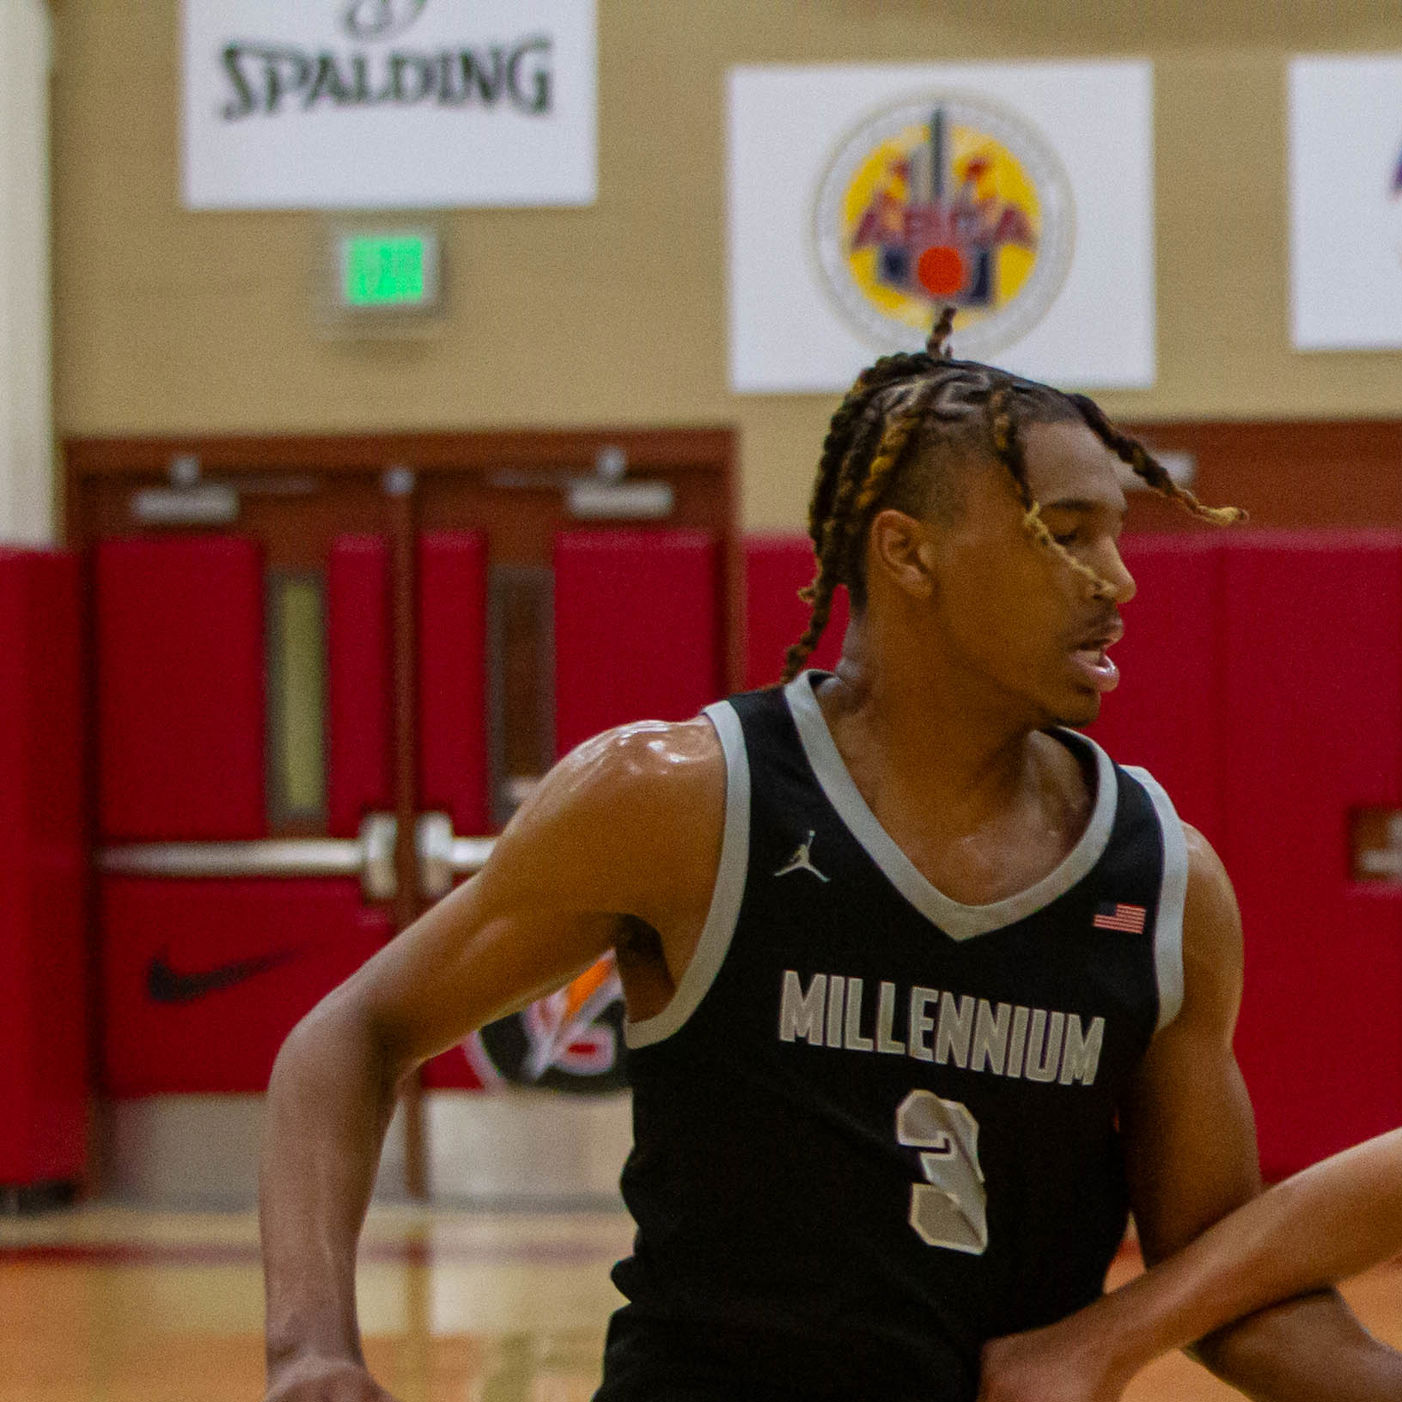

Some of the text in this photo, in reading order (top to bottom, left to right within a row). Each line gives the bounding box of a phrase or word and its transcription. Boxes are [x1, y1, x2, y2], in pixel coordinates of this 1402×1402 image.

[221, 33, 555, 123] SPALDING
[779, 969, 1106, 1086] MILLENNIUM
[896, 1089, 989, 1256] 3
